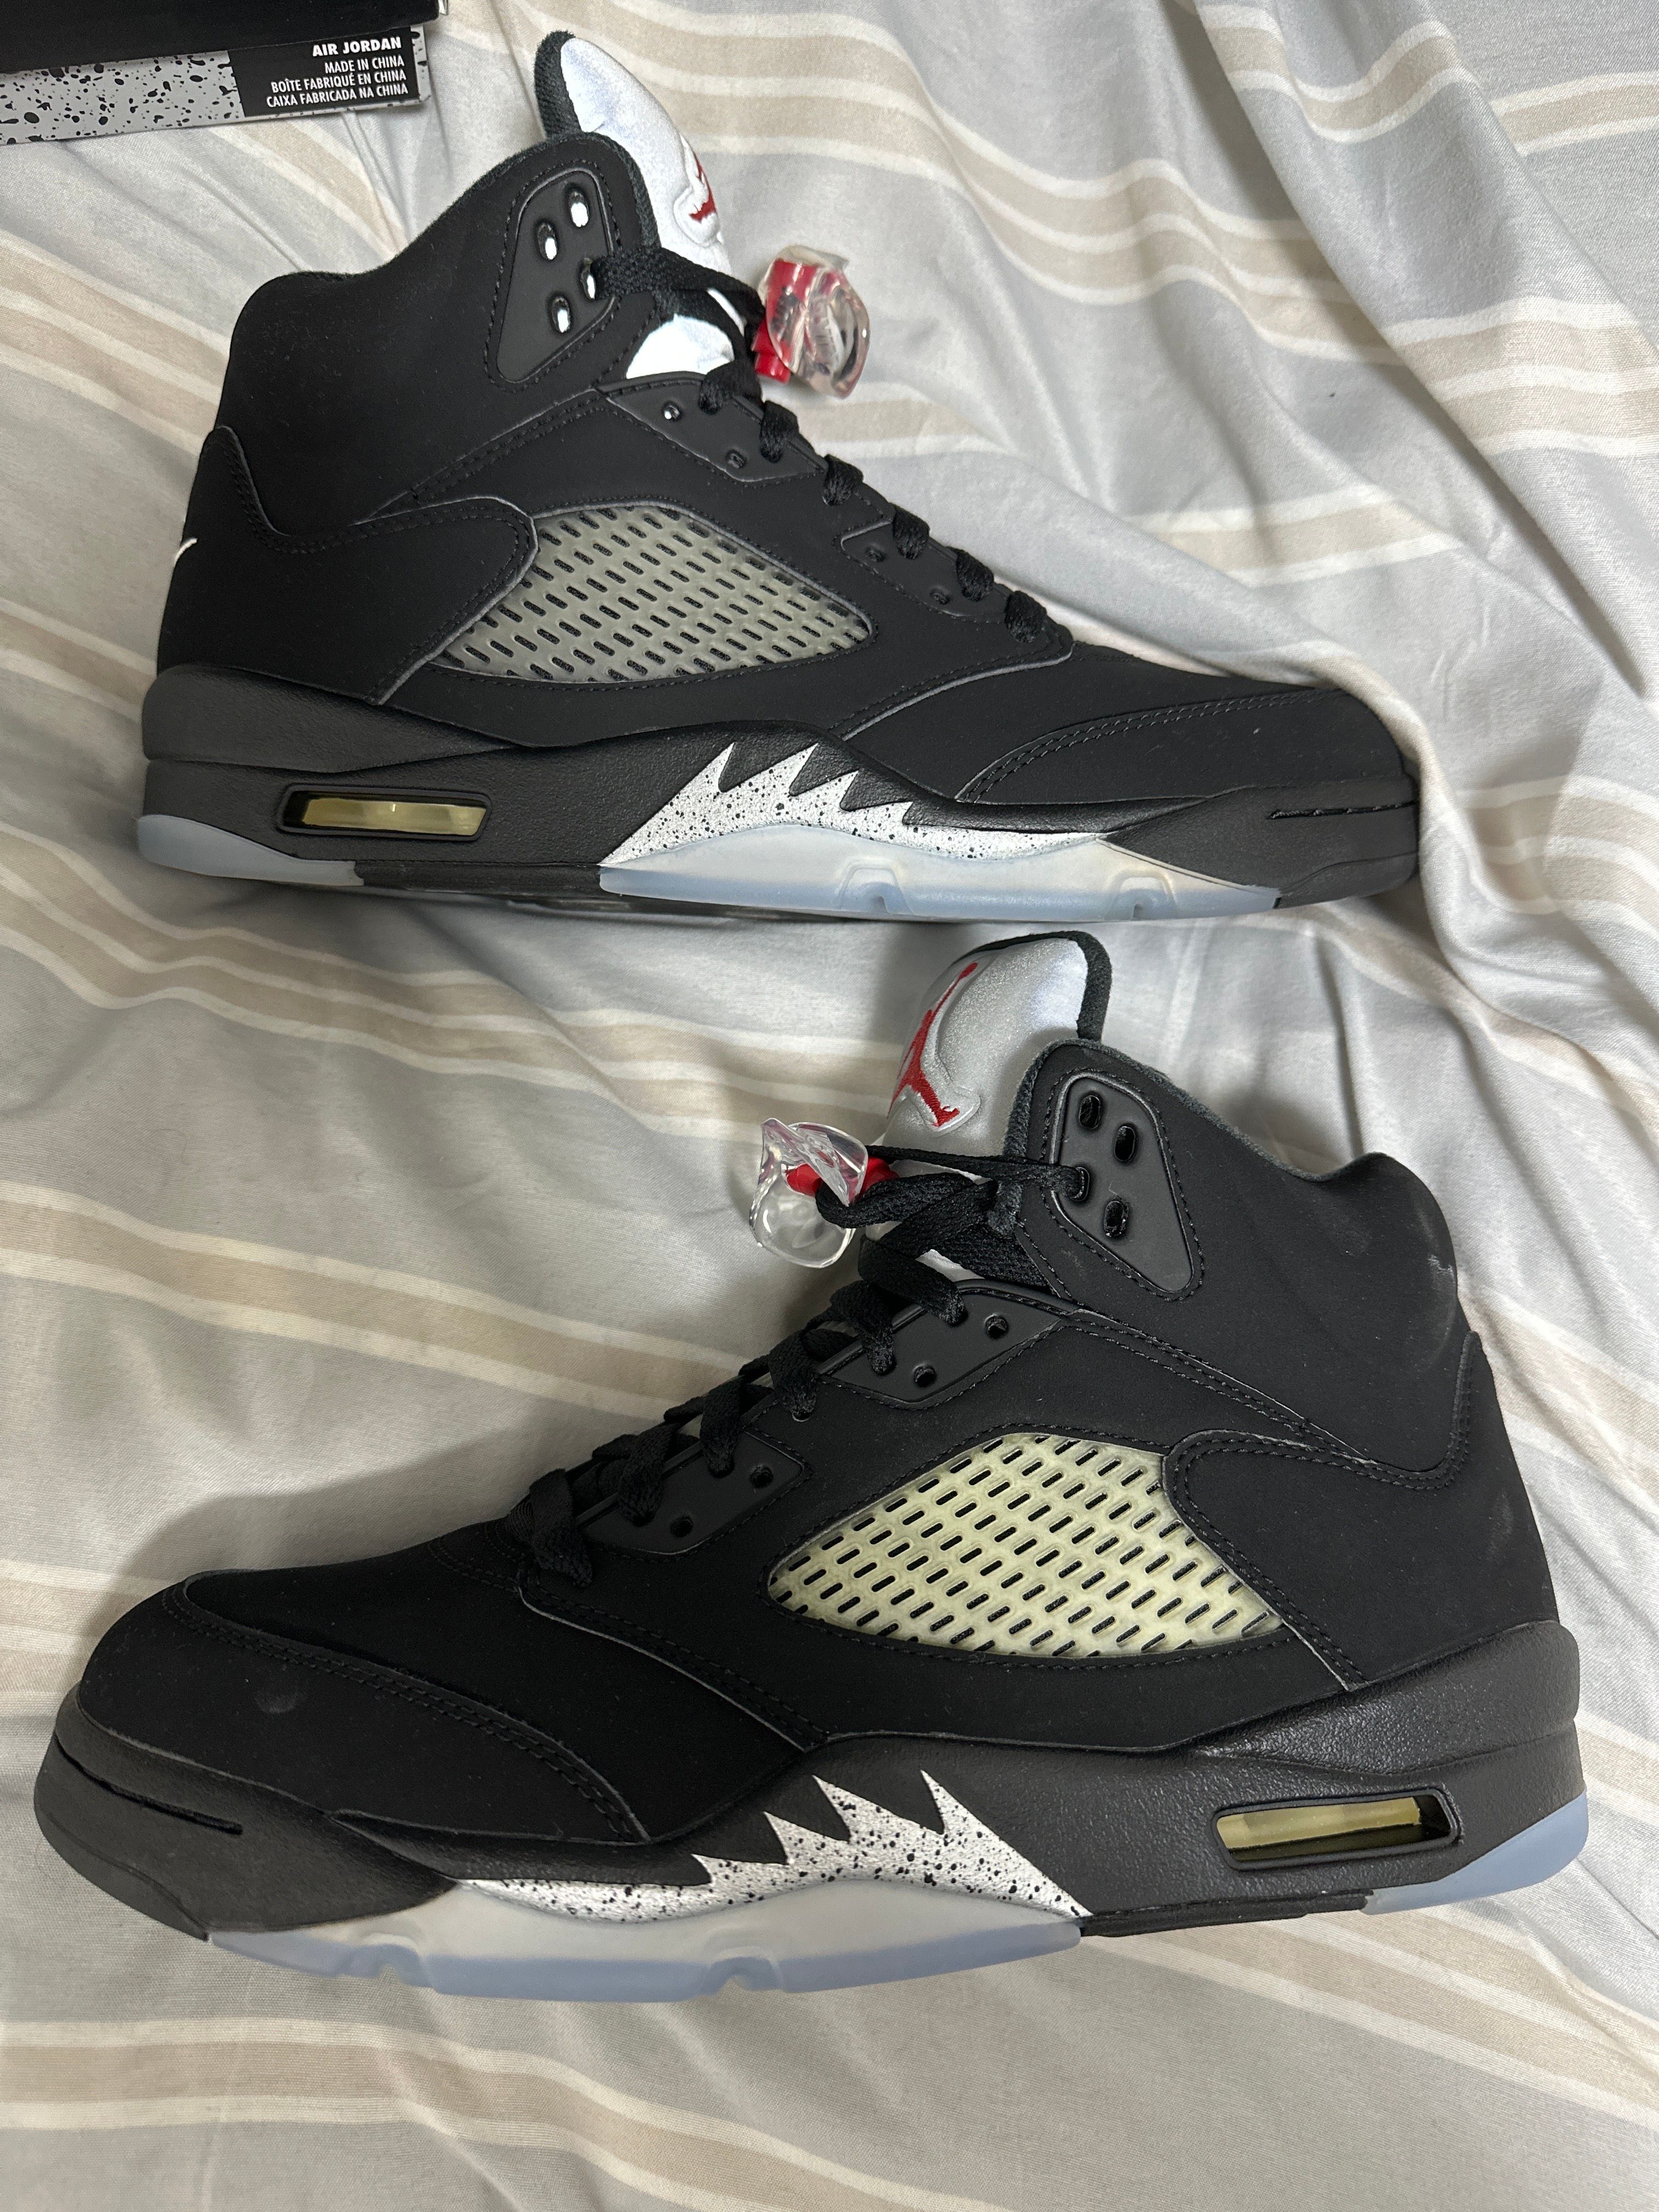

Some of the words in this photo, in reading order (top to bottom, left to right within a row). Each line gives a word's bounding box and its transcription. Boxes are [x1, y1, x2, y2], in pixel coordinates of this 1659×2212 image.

[313, 43, 338, 57] AIR
[343, 37, 402, 54] JORDAN
[324, 59, 355, 74] MADE
[357, 58, 369, 71] IN
[372, 54, 405, 69] CHINA
[271, 77, 302, 93] BOÎTE
[303, 72, 356, 90] FABRIQUÉ
[358, 72, 371, 85] EN
[374, 69, 407, 83] CHINA
[267, 94, 298, 108] CAIXA
[300, 88, 357, 105] FABRICADA
[358, 86, 375, 99] NA
[376, 83, 409, 97] CHINA
